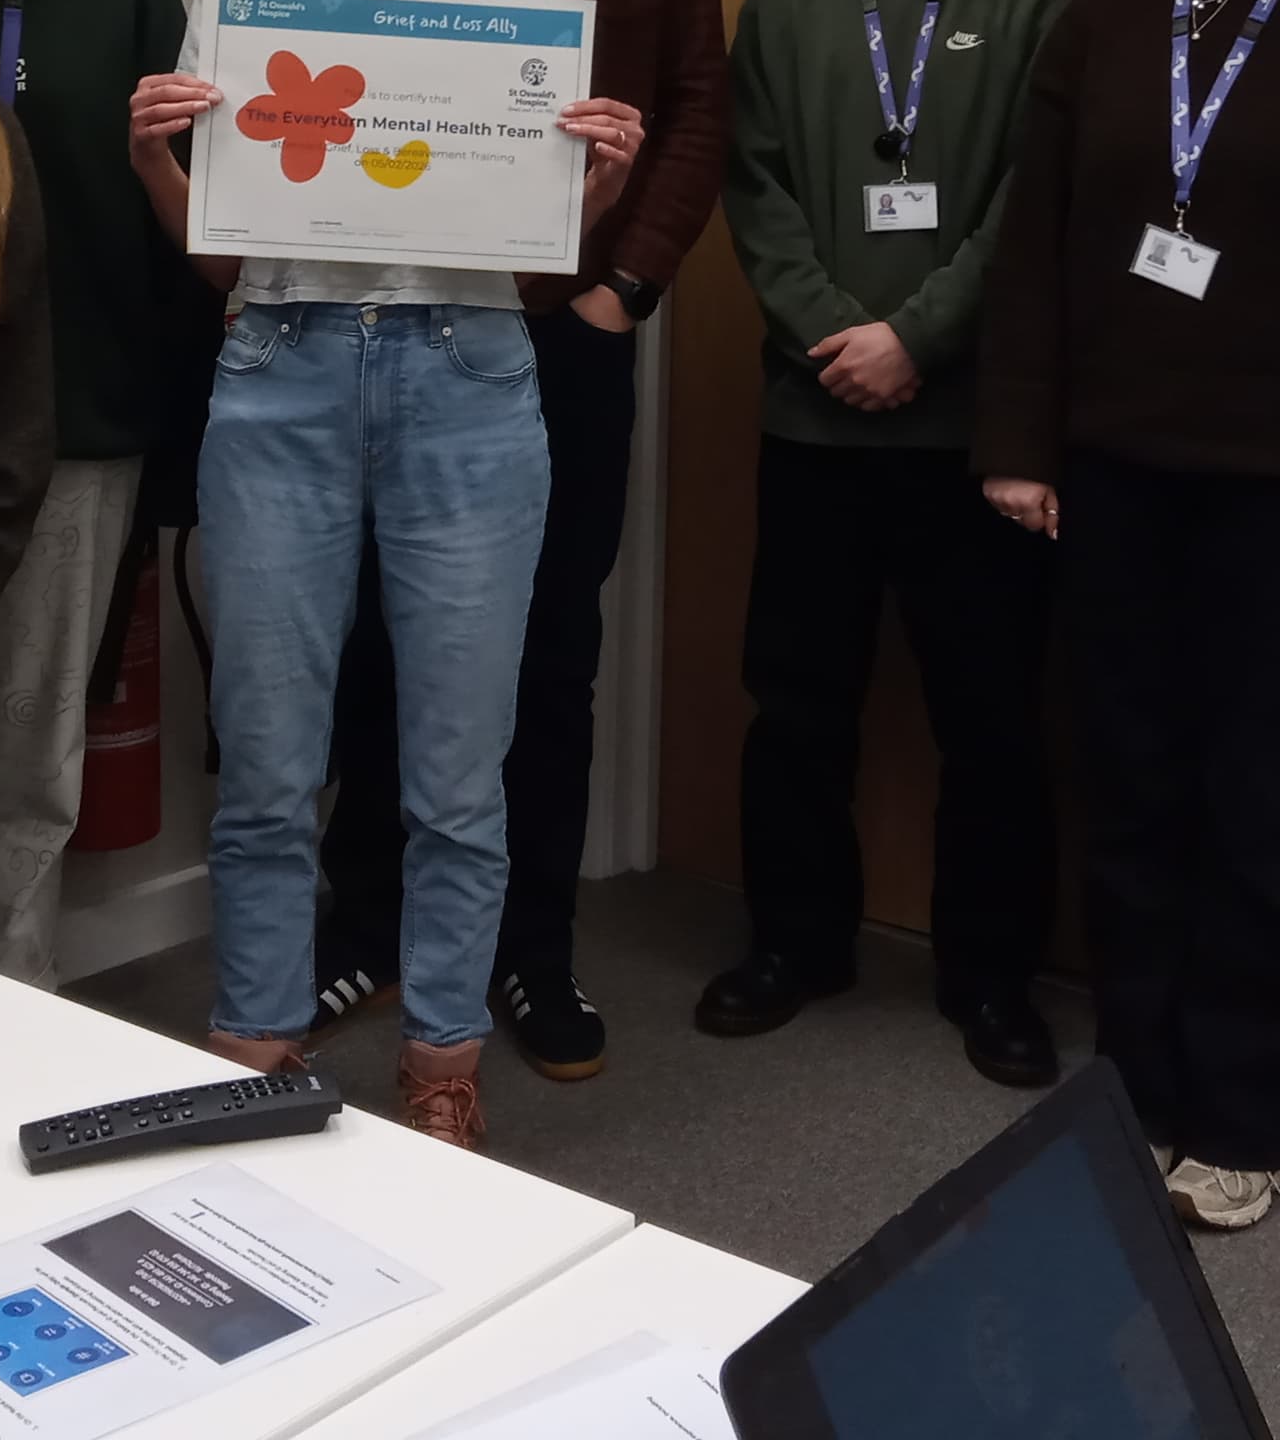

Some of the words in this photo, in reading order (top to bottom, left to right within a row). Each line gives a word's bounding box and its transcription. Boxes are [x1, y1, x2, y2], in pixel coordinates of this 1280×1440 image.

[374, 10, 416, 31] Grief
[420, 15, 448, 29] and
[453, 15, 482, 31] Loss
[486, 17, 518, 40] Ally
[379, 92, 389, 101] to
[393, 93, 426, 105] certify
[429, 94, 452, 105] that
[508, 88, 518, 96] St
[515, 98, 548, 107] Hospice
[283, 111, 366, 128] Everyturn
[372, 116, 431, 132] Mental
[436, 120, 492, 136] Health
[497, 124, 544, 139] Team
[470, 151, 516, 165] Training
